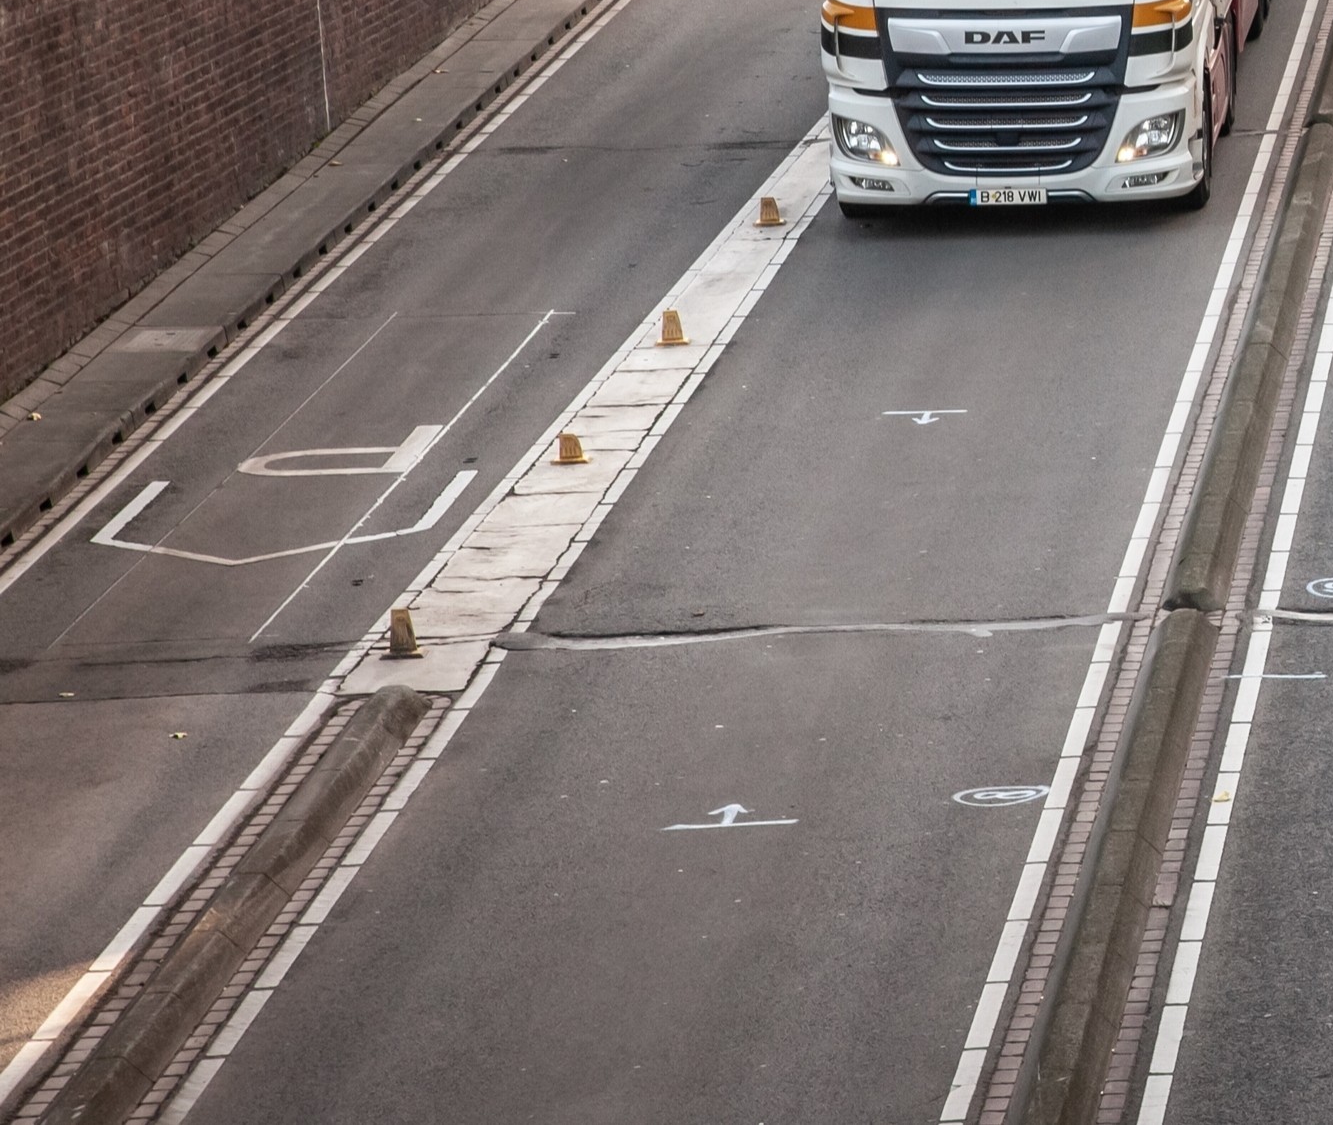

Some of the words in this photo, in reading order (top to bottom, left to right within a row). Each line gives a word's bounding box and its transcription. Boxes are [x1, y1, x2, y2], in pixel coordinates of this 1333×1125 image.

[965, 31, 1046, 44] DAF
[981, 191, 989, 203] B
[995, 191, 1014, 202] 218
[1018, 190, 1041, 202] VWI
